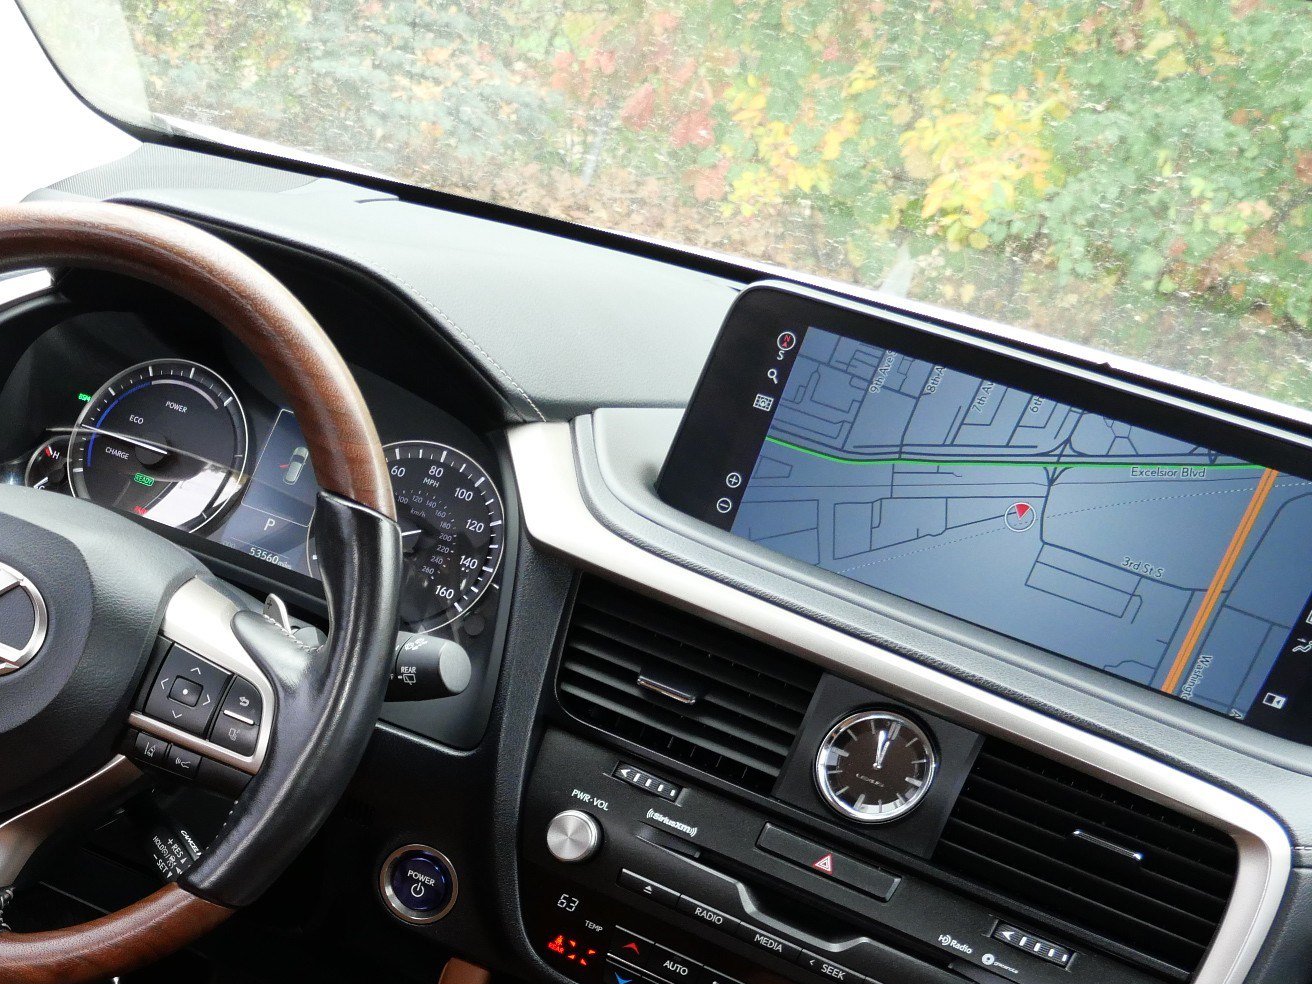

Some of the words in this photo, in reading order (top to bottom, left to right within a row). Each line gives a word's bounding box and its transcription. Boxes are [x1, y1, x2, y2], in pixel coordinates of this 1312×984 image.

[776, 350, 786, 361] S
[868, 377, 883, 394] 9th
[878, 356, 896, 378] Ave
[925, 375, 941, 394] 8th
[165, 400, 188, 413] POWER
[971, 395, 988, 413] 7th
[128, 414, 144, 425] ECO
[52, 450, 60, 460] H
[104, 446, 130, 460] CHARGE
[390, 465, 406, 478] 60
[428, 465, 444, 478] 80
[1130, 467, 1178, 478] Excelsior
[1180, 467, 1207, 478] Blvd
[422, 477, 440, 488] MPH
[397, 495, 409, 505] 100
[454, 487, 474, 502] 100
[410, 508, 426, 518] km/h
[263, 518, 276, 531] P
[465, 519, 484, 533] 120
[438, 532, 452, 542] 200
[248, 547, 279, 564] 53560
[436, 545, 450, 554] 220
[430, 556, 443, 565] 240
[459, 555, 478, 569] 140
[1121, 556, 1142, 572] 3rd
[1141, 562, 1154, 577] St
[1156, 567, 1165, 578] S
[435, 585, 454, 599] 160
[180, 830, 199, 853] CANCEL
[156, 859, 168, 873] SET
[407, 869, 436, 887] POWER
[557, 893, 579, 912] 63
[694, 907, 724, 925] RADIO
[584, 920, 604, 933] TEMP
[754, 934, 783, 953] MEDIA
[950, 940, 973, 954] Radio
[663, 960, 689, 976] AUTO
[821, 963, 847, 981] SEEK
